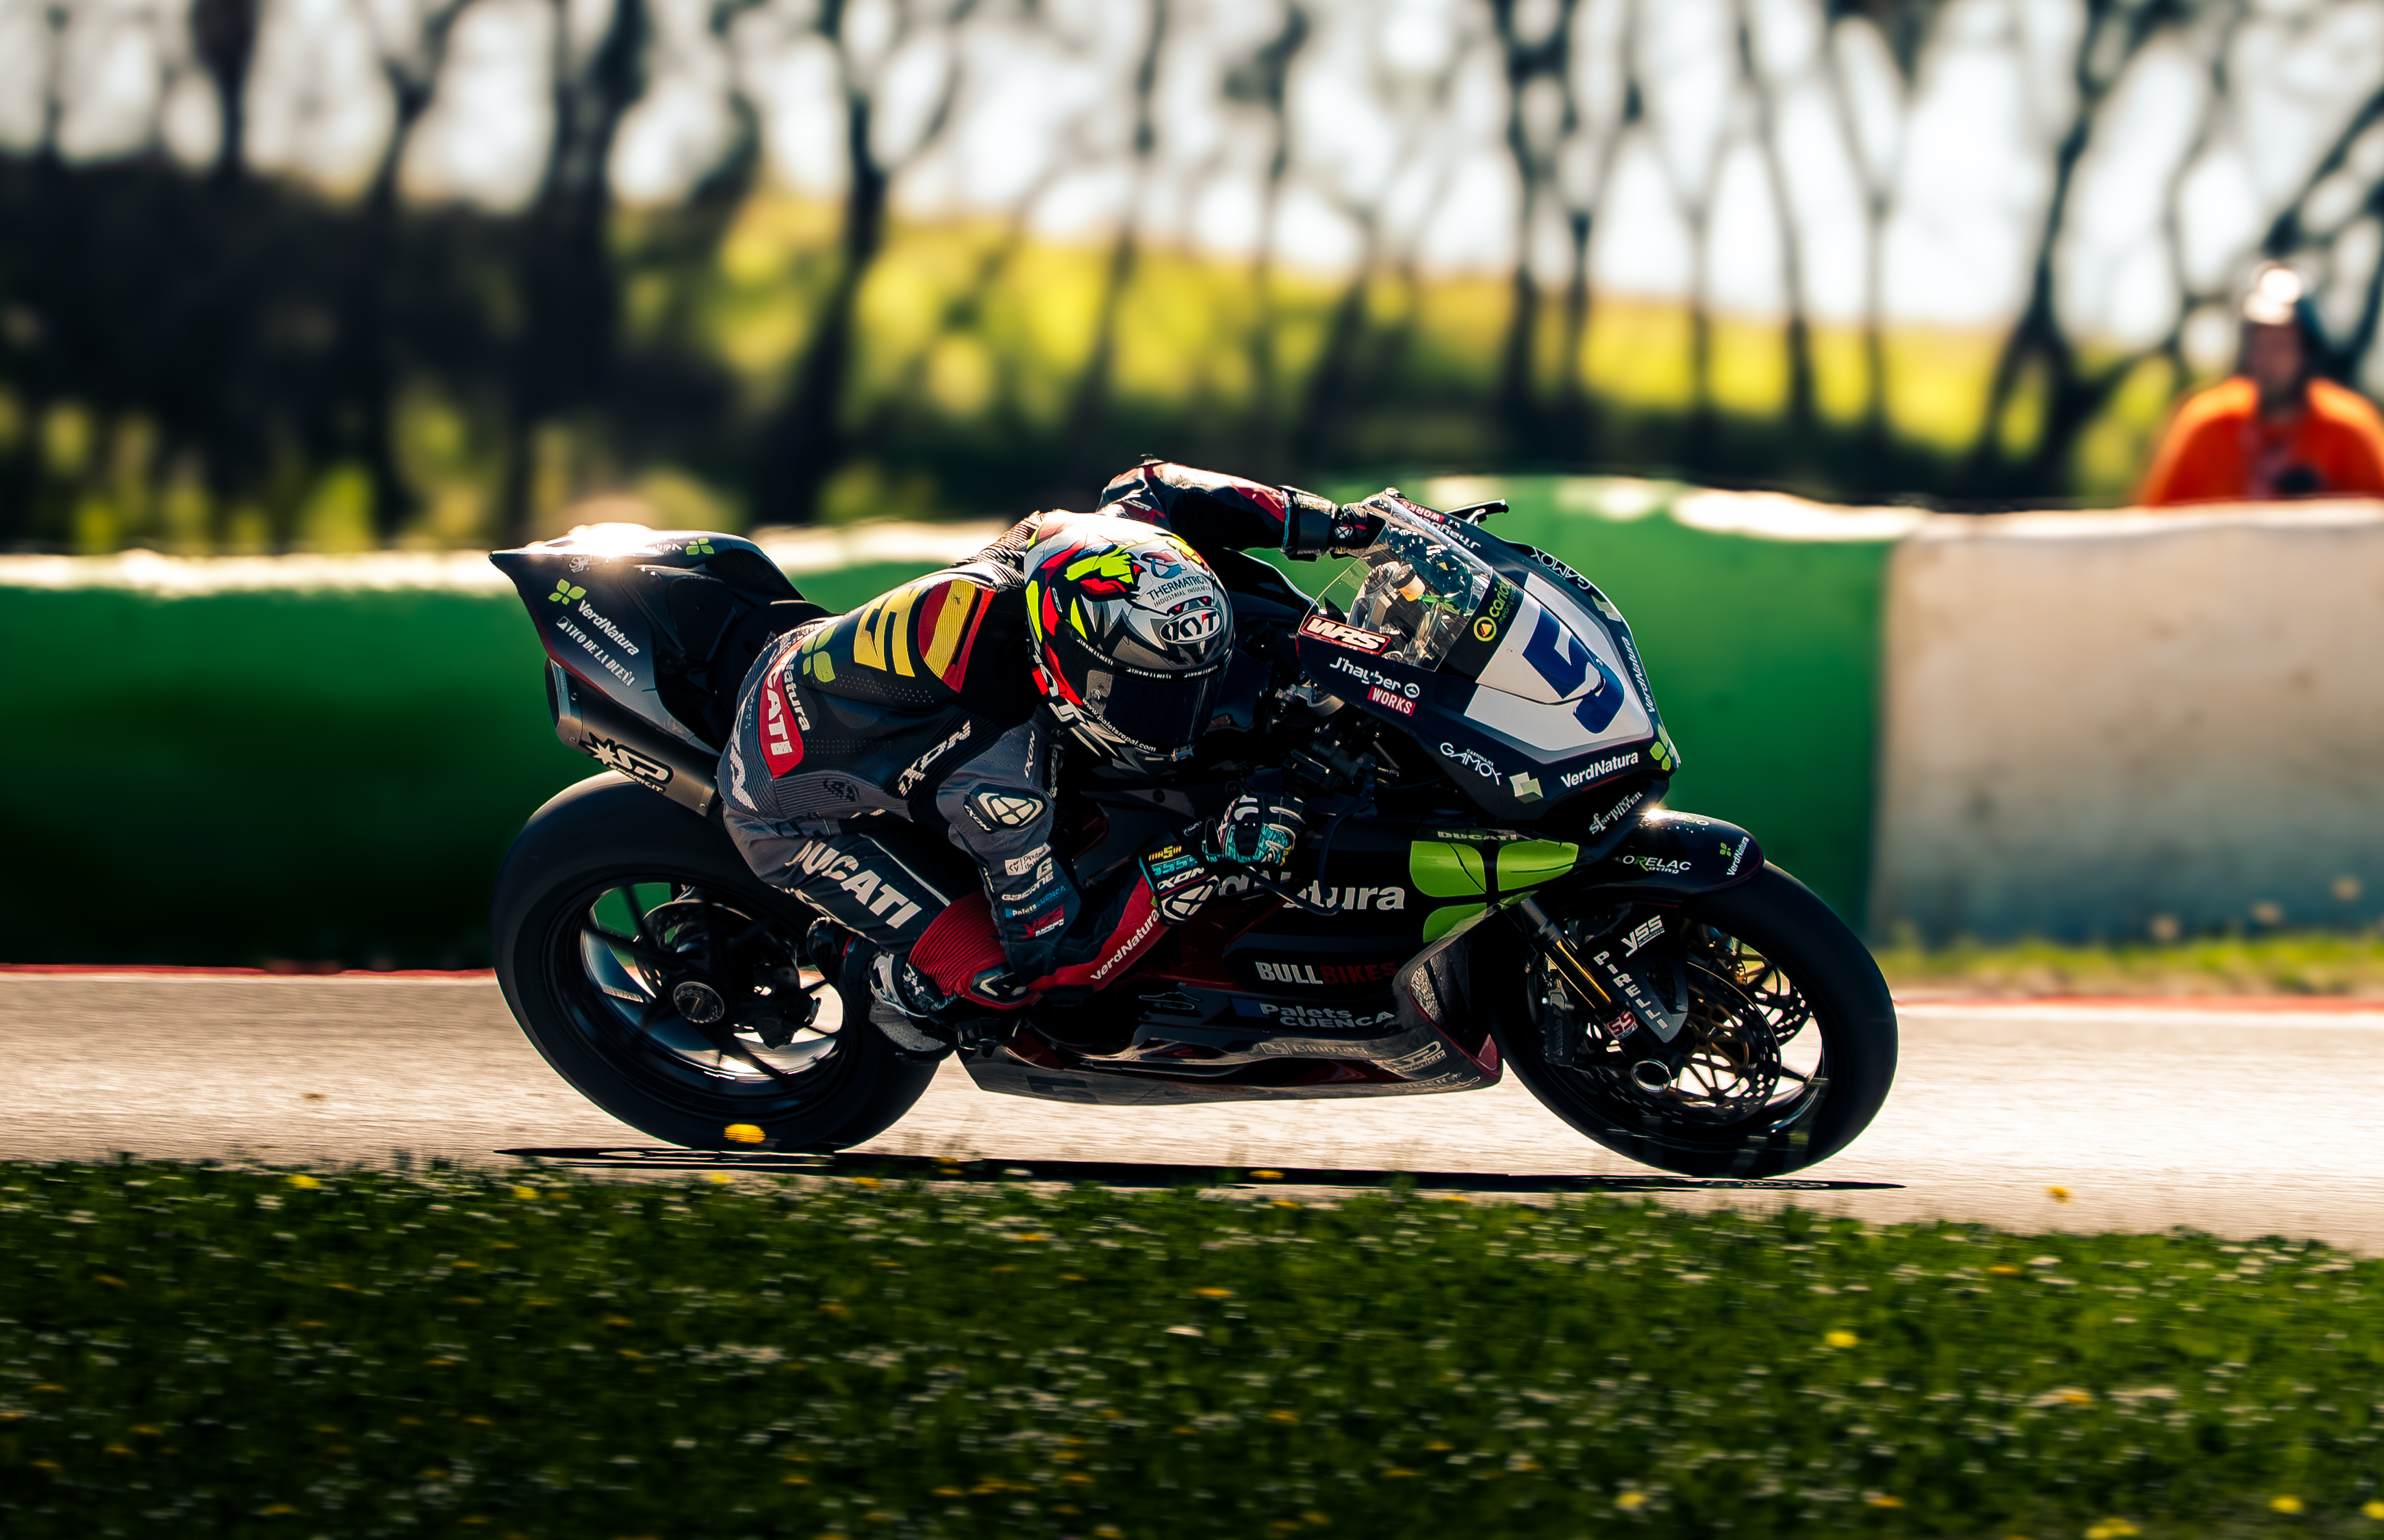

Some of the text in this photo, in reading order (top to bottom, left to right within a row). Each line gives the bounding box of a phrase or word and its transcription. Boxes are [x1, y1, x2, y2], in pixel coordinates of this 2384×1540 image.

[1154, 591, 1186, 608] INDUSTRIAL
[578, 600, 639, 656] VerdNatura
[1306, 617, 1386, 650] WRS
[594, 650, 605, 665] LA
[1329, 656, 1401, 691] J'hayber
[1521, 605, 1624, 734] 5
[1621, 636, 1656, 713] VerdNatura
[1371, 687, 1412, 715] WORKS
[1560, 752, 1639, 788] VerdNatura
[1438, 830, 1518, 841] DUCATI
[1623, 856, 1692, 871] ORELAC
[1727, 836, 1750, 876] VerdNatura
[1593, 950, 1669, 1029] PIRELLI
[1258, 1003, 1352, 1020] Palets
[1280, 1011, 1395, 1028] CUENCA
